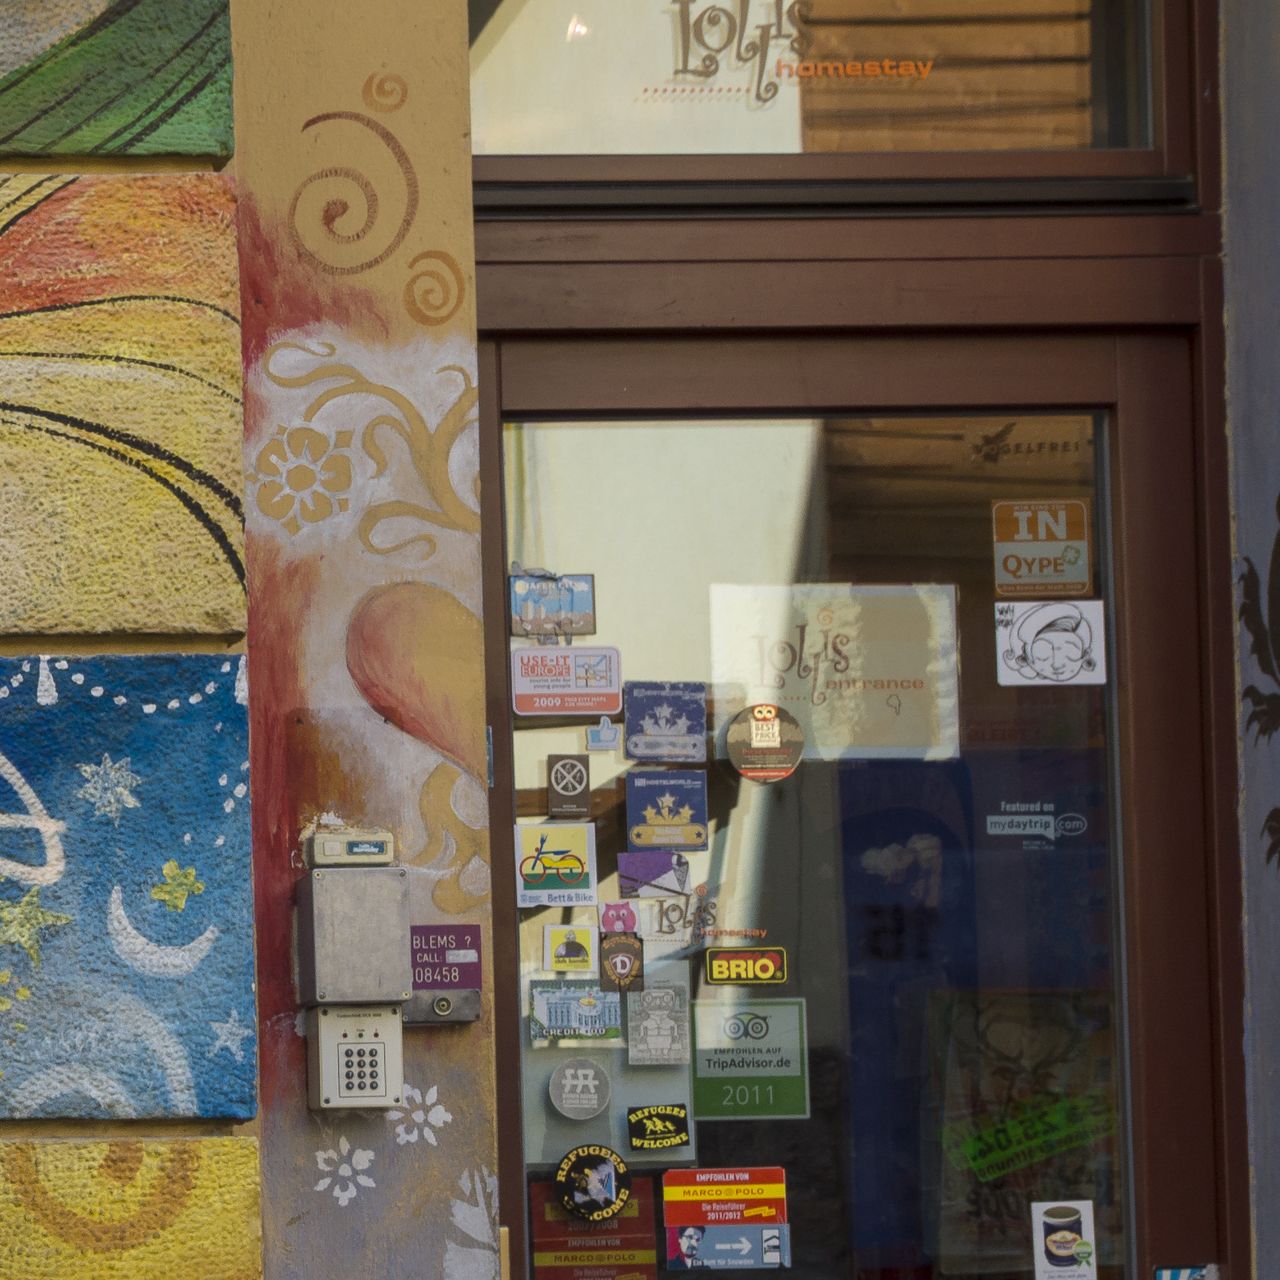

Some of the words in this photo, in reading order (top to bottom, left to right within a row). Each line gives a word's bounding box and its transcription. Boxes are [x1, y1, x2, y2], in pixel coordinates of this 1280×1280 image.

[775, 57, 935, 80] homestay
[1013, 511, 1067, 540] IN
[1002, 554, 1065, 579] QYPE
[520, 655, 570, 666] USE-IT
[520, 665, 571, 678] EUROPE
[826, 678, 927, 691] entrance
[533, 697, 561, 707] 2009
[1000, 801, 1041, 812] Featured
[1043, 803, 1055, 811] on
[412, 935, 457, 950] BLEMS
[464, 935, 471, 949] ?
[416, 953, 442, 963] CALL:
[411, 967, 460, 983] 08458
[712, 957, 776, 980] BRIO
[705, 1056, 791, 1071] TripAdvisor.de
[722, 1085, 774, 1105] 2011
[628, 1105, 687, 1123] REFUGEES
[632, 1132, 689, 1149] WELCOME
[556, 1146, 628, 1183] REFUGEES
[696, 1173, 735, 1182] EMPFOHLEN
[735, 1172, 749, 1181] VON
[683, 1189, 722, 1197] MARCO
[735, 1188, 765, 1196] POLO
[554, 1254, 594, 1263] MARCO
[607, 1253, 636, 1262] POLO
